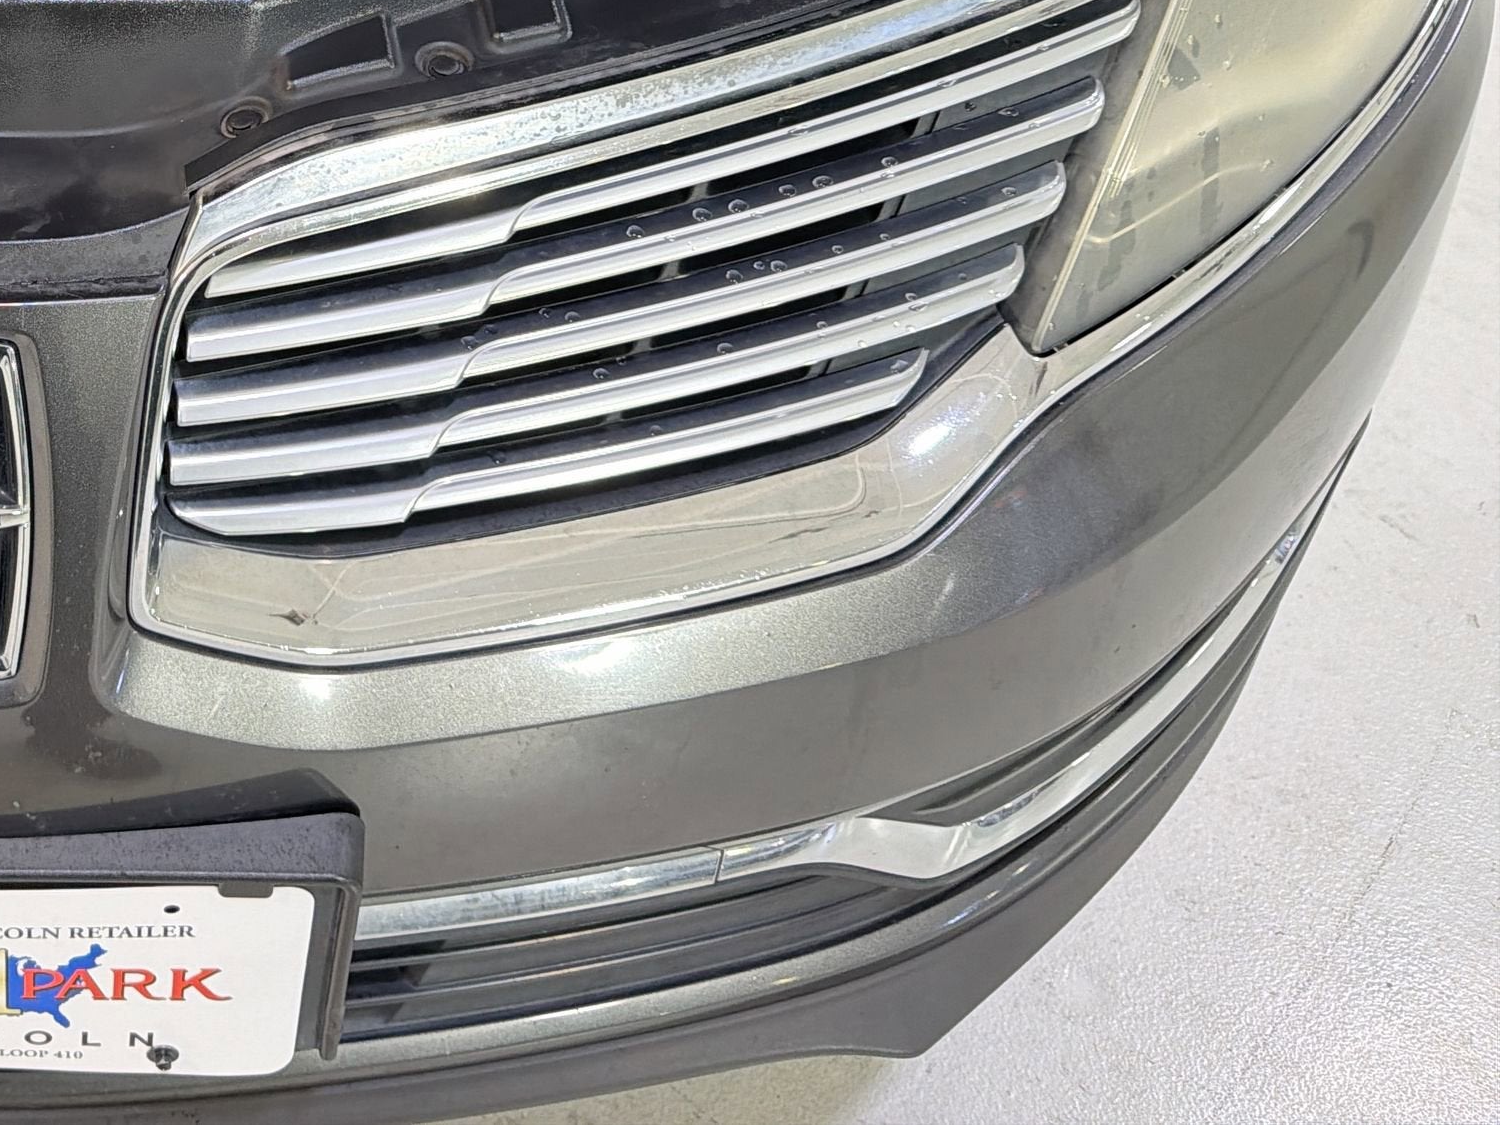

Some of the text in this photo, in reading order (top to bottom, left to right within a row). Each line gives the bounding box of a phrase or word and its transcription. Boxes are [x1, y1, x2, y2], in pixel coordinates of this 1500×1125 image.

[68, 925, 196, 940] RETAILER
[21, 967, 233, 1002] PARK
[0, 1049, 49, 1058] LOOP
[53, 1050, 84, 1060] 410
